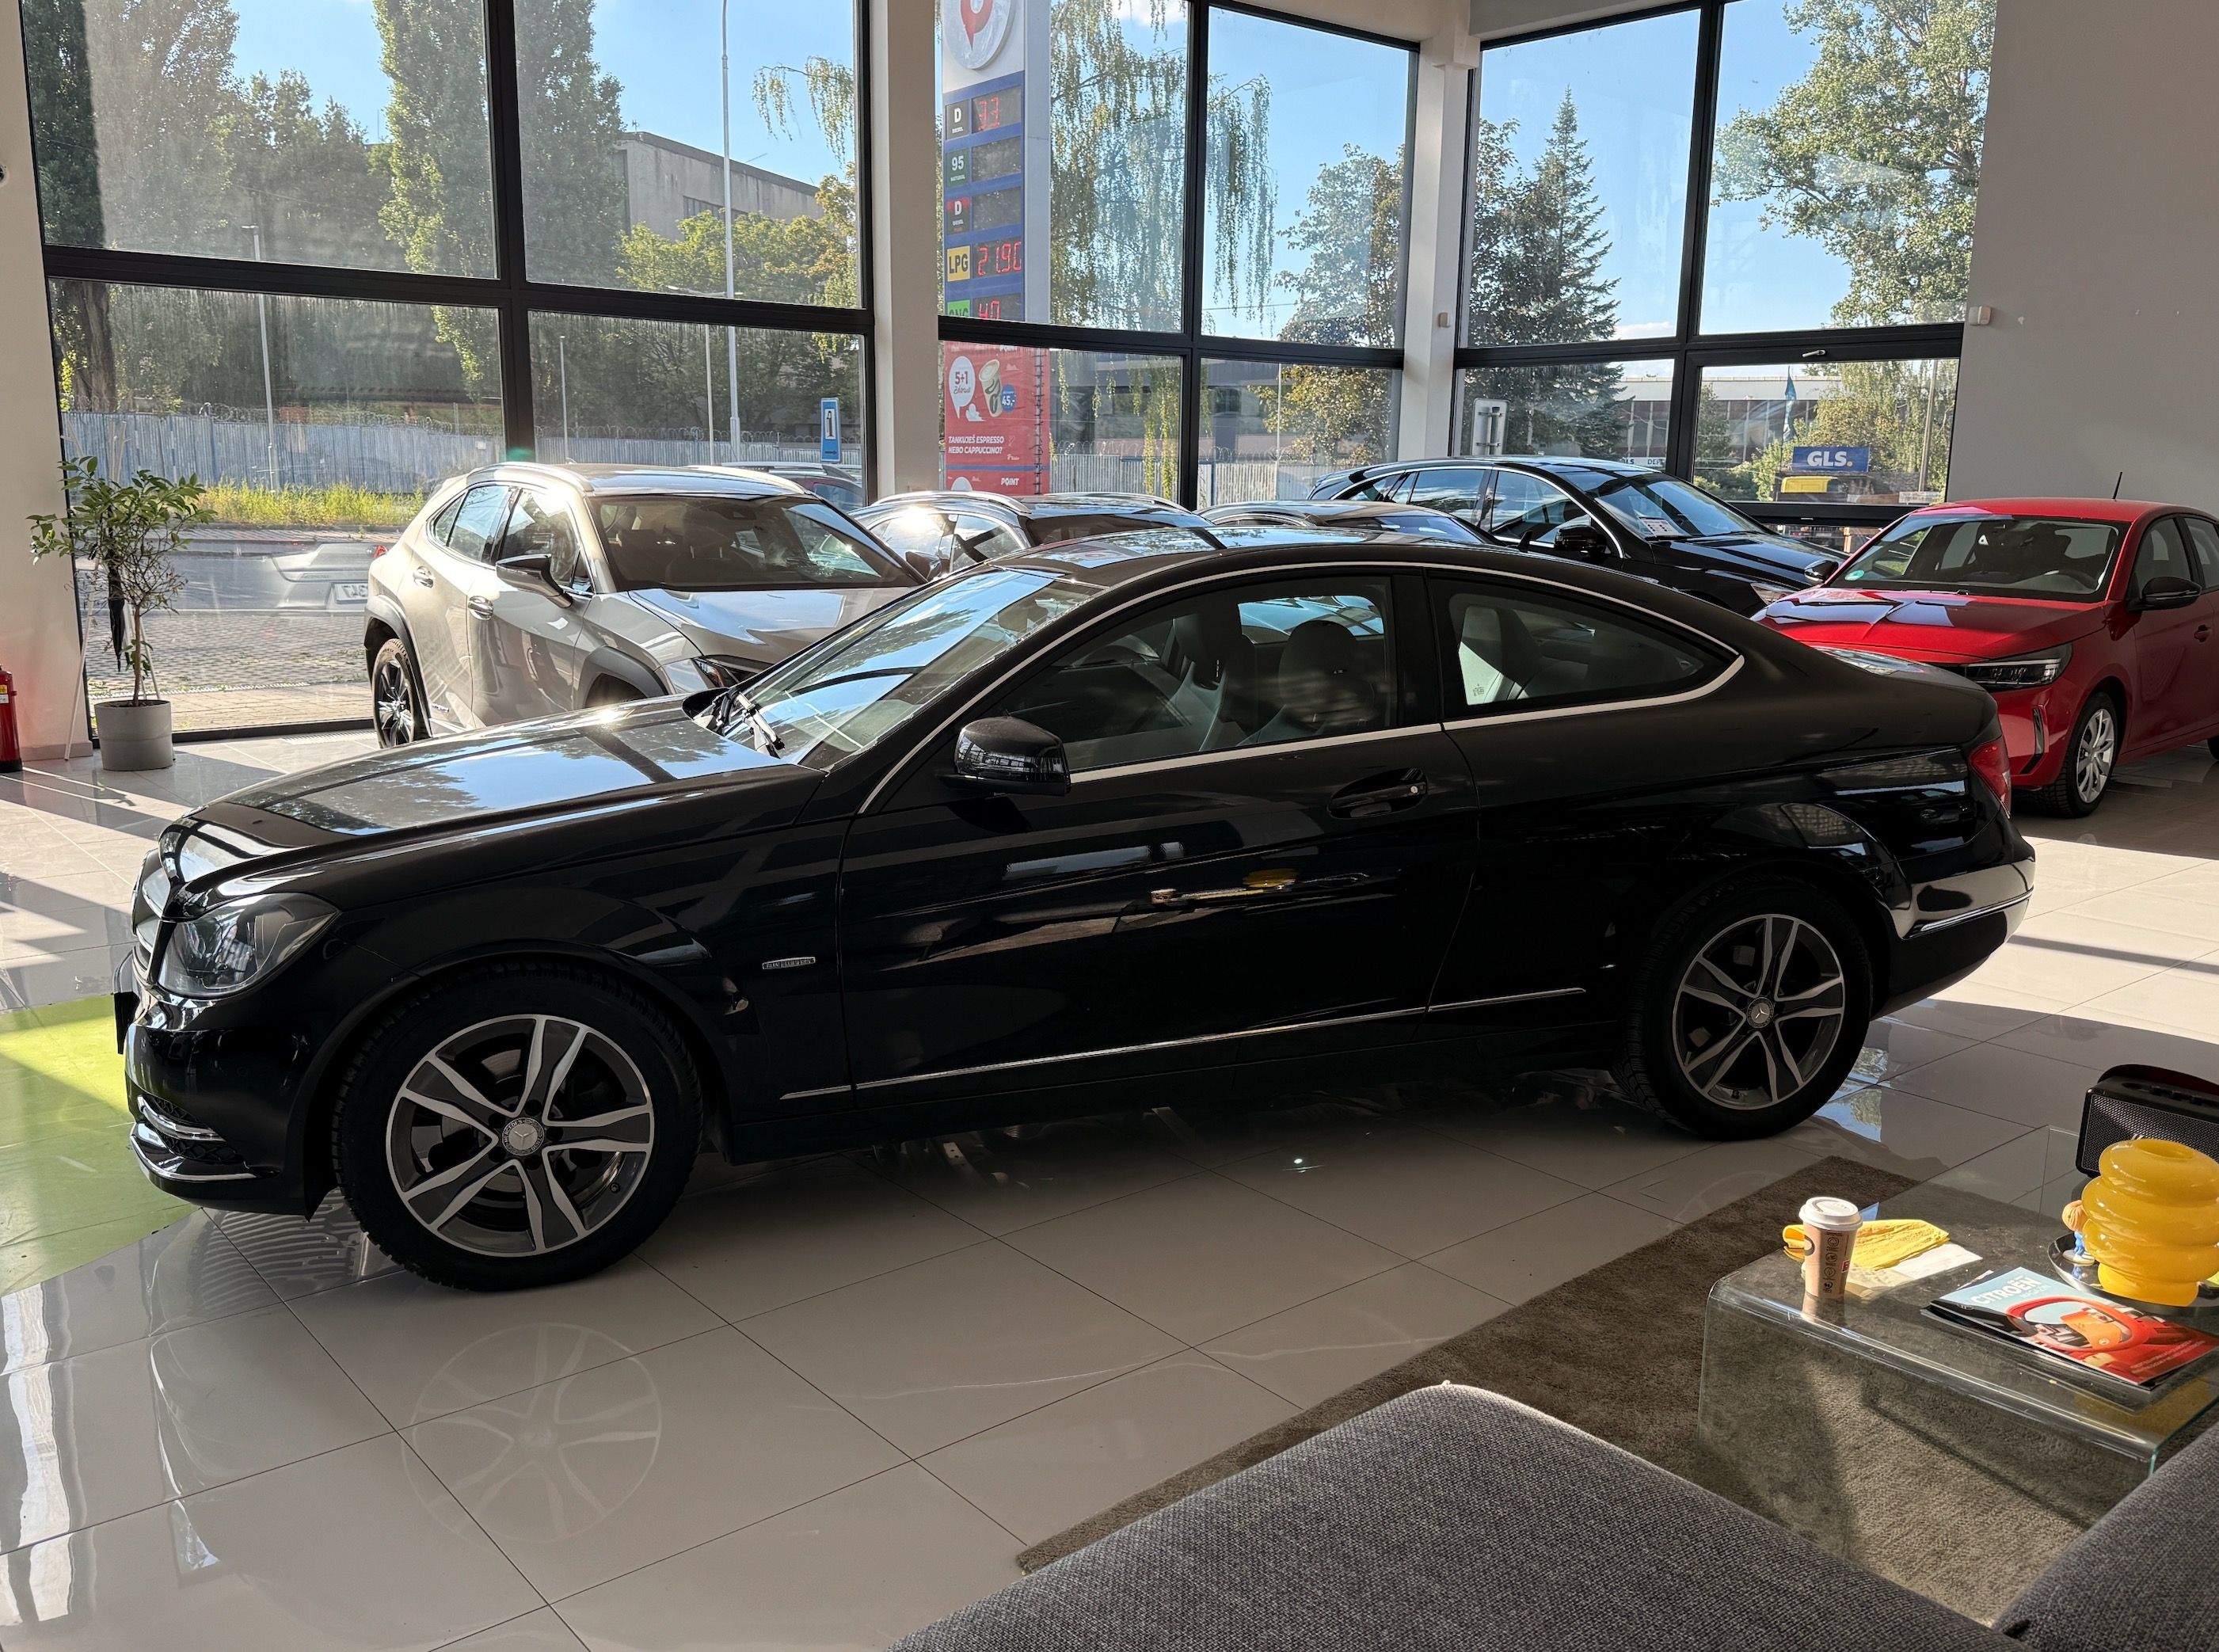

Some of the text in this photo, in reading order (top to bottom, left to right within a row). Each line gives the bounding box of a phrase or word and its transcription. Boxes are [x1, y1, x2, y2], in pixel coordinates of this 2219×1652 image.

[954, 108, 961, 123] D
[952, 155, 964, 171] 95
[954, 200, 962, 216] D
[949, 253, 969, 274] LPG
[955, 371, 969, 385] 5+1
[949, 434, 1004, 444] TANKUJEŠ ESPRESSO
[964, 446, 1003, 455] CAPPUCCINO?
[1000, 477, 1019, 485] POINT
[1970, 1276, 2042, 1305] CITROËN
